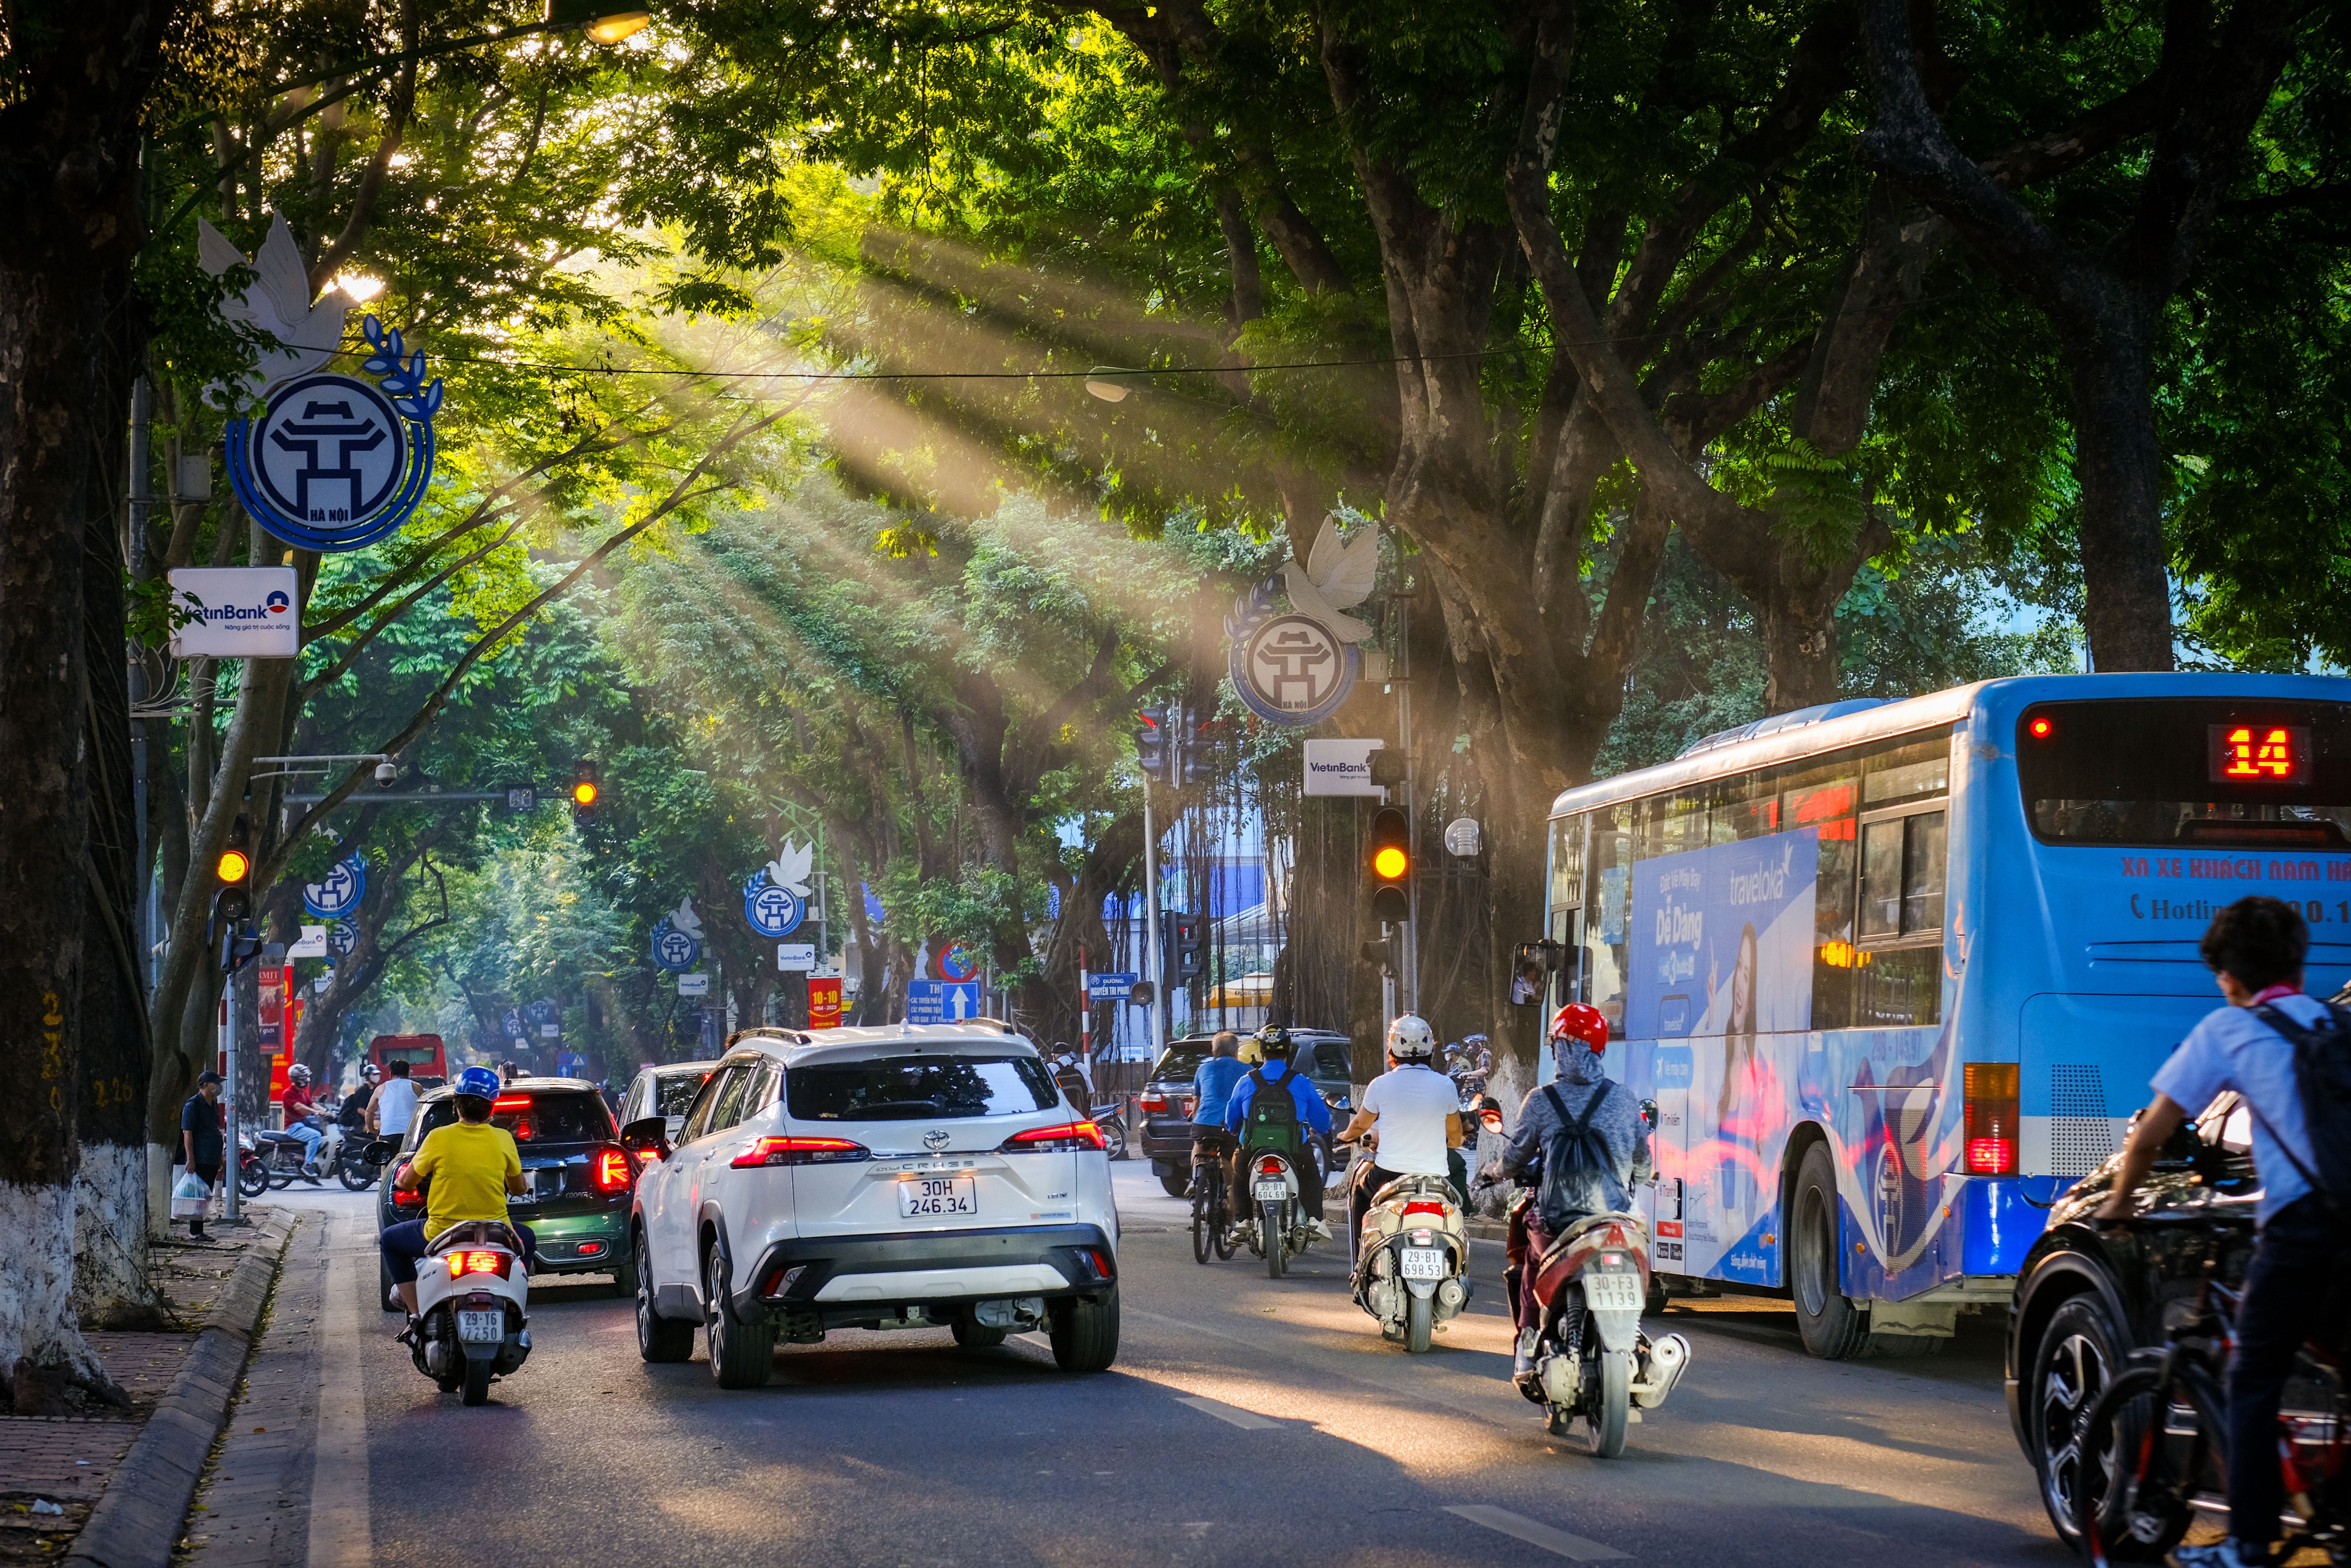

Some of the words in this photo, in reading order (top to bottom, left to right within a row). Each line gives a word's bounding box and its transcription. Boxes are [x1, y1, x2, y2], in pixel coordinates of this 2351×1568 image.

[310, 508, 325, 521] HÀ
[329, 508, 348, 524] NỘI
[183, 605, 267, 620] etinBank
[2227, 729, 2290, 775] 14
[1310, 763, 1366, 772] VietinBank
[2156, 857, 2181, 878] XE
[2189, 855, 2261, 879] KHÁCH
[1731, 860, 1783, 905] traveloka
[921, 1180, 953, 1196] 30H
[910, 1197, 967, 1214] 246.34
[1408, 1251, 1436, 1263] 29-B1
[1405, 1264, 1440, 1276] 698.53
[1594, 1276, 1634, 1290] 30-F3
[1597, 1292, 1636, 1306] 1139
[465, 1327, 497, 1340] 7250
